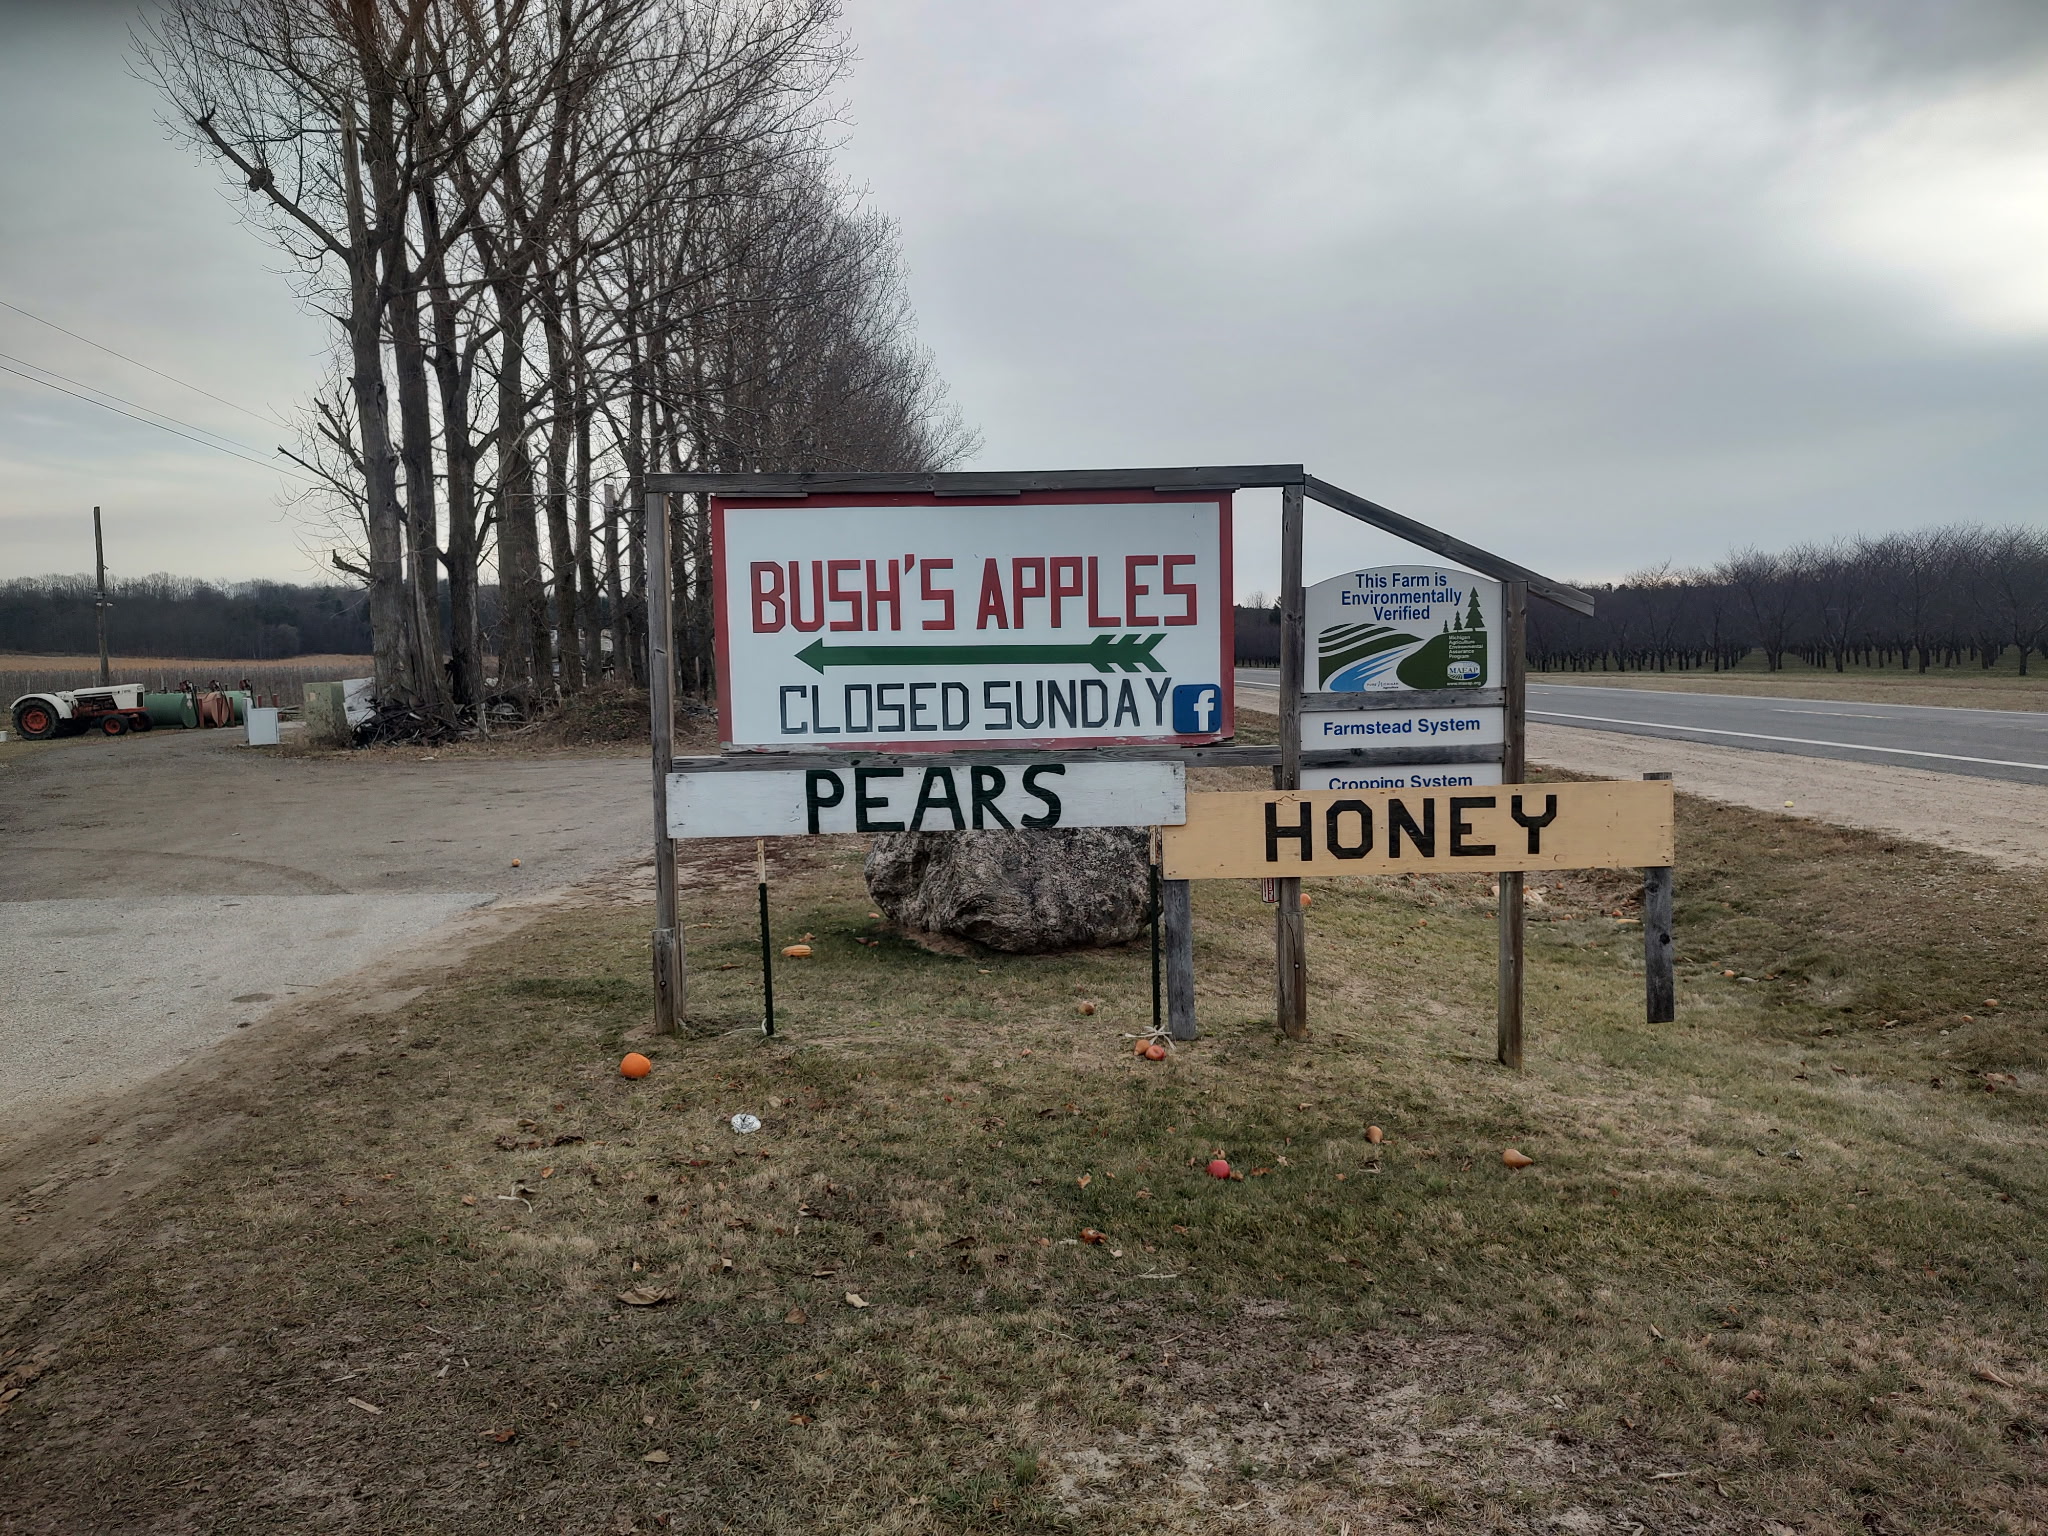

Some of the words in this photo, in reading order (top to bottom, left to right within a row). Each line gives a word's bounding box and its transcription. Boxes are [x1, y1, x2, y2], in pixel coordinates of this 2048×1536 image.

[750, 554, 955, 634] BUSH'S
[976, 554, 1198, 631] APPLES
[1341, 587, 1462, 606] Environmentally
[1355, 573, 1388, 588] This
[1392, 573, 1429, 588] Farm
[1434, 572, 1447, 586] is
[1373, 605, 1430, 620] Verified
[779, 682, 970, 734] CLOSED
[983, 677, 1172, 731] SUNDAY
[1323, 719, 1412, 736] Farmstead
[1418, 718, 1480, 735] System
[805, 763, 1067, 834] PEARS
[1264, 793, 1558, 863] HONEY
